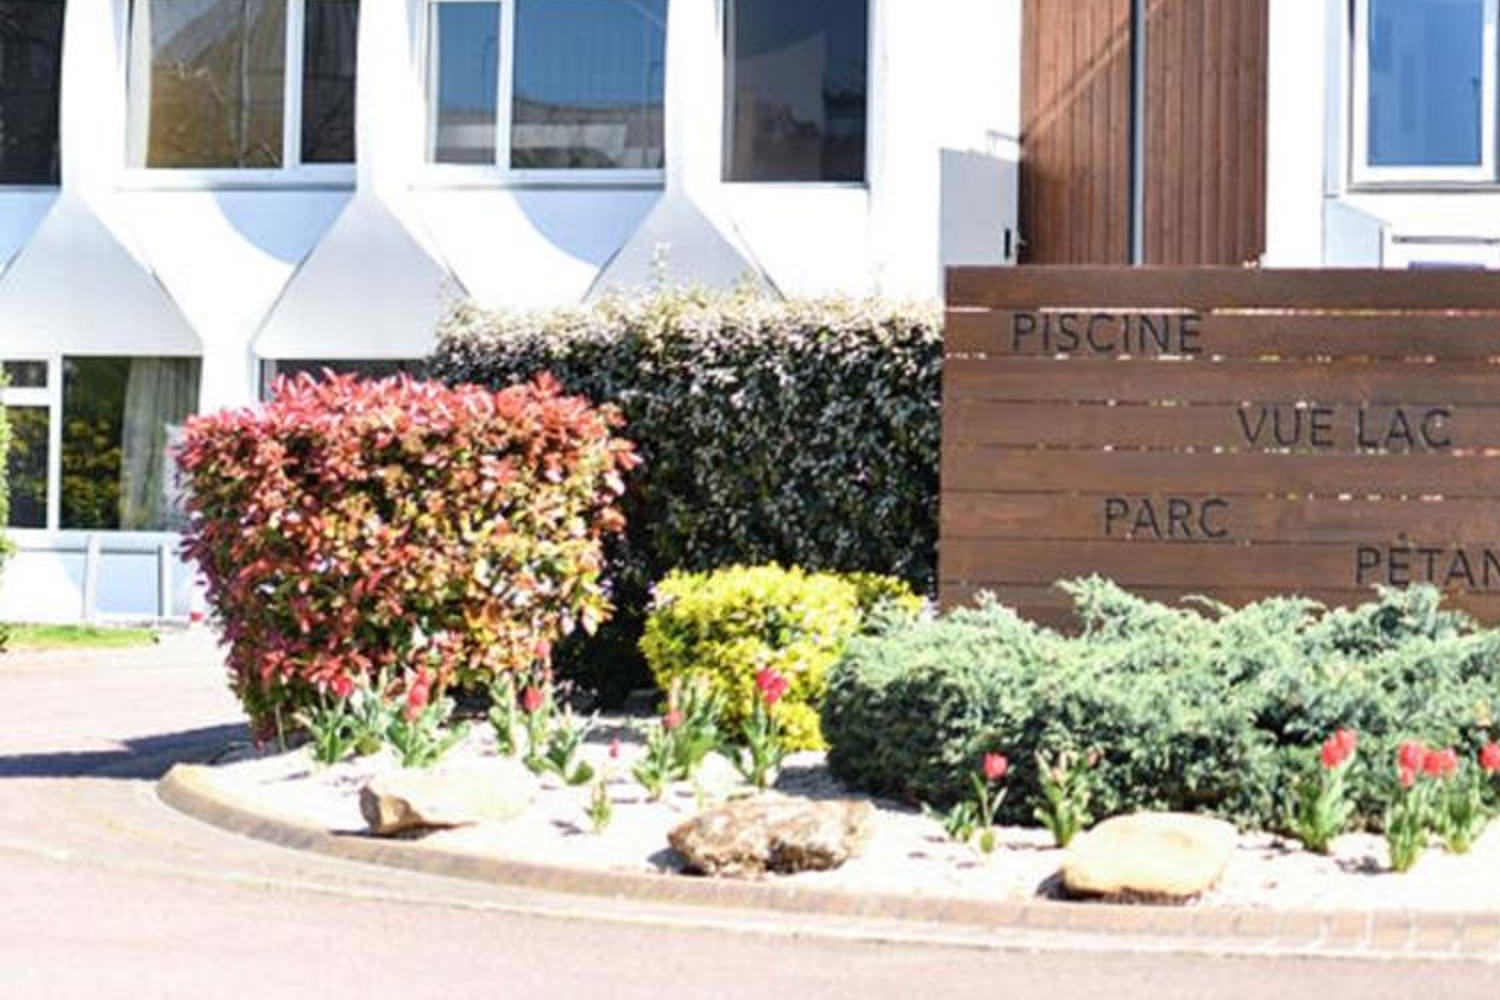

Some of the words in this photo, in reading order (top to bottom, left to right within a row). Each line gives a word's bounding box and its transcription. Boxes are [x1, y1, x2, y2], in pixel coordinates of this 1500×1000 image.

[1012, 313, 1203, 354] PISCINE
[1238, 407, 1334, 447] VUE
[1356, 408, 1453, 449] LAC
[1104, 498, 1230, 538] PARC
